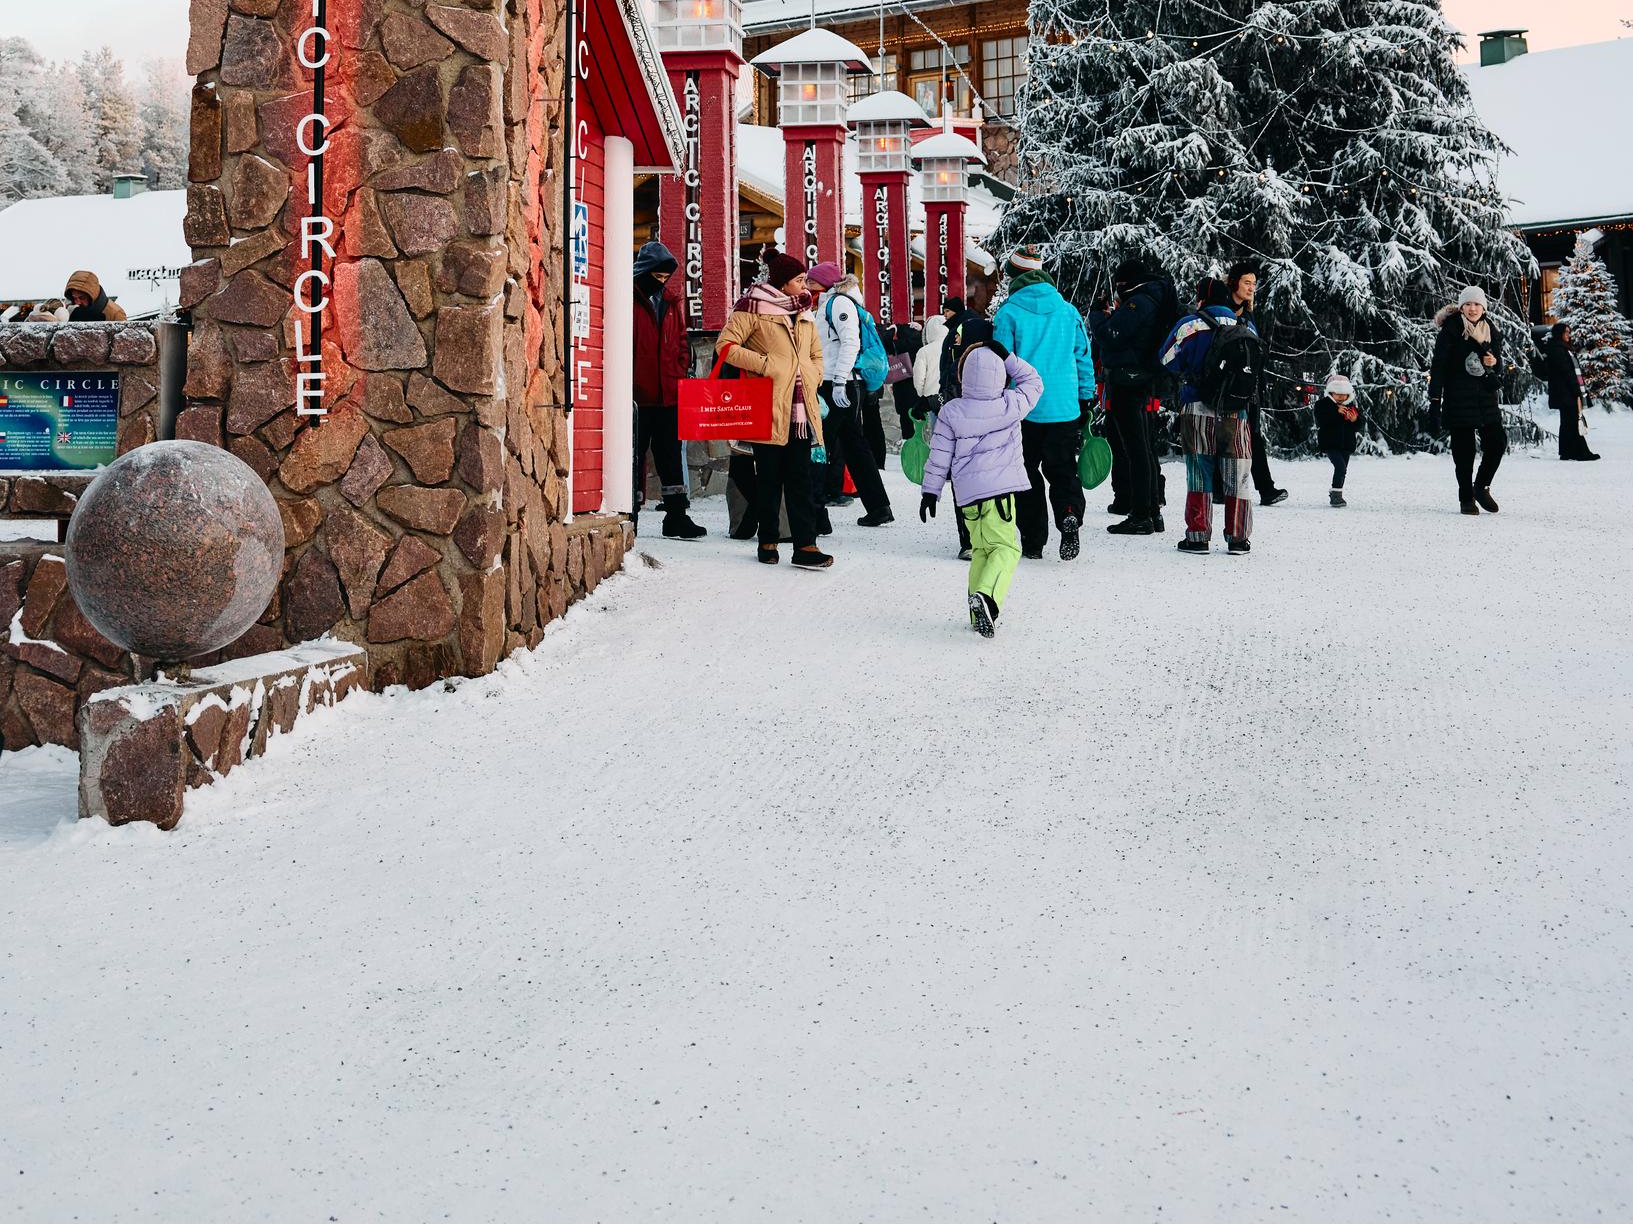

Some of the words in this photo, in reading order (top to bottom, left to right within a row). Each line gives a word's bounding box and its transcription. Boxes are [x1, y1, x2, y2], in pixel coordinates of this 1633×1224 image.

[683, 77, 700, 187] ARCTIC
[803, 147, 817, 234] ARCTIC
[874, 188, 887, 259] ARCTIC
[294, 113, 337, 416] CIRCLE
[685, 203, 702, 316] CIRCLE
[939, 214, 948, 274] ARCTIC
[878, 271, 891, 324] CIRC
[40, 379, 120, 390] CIRCLE
